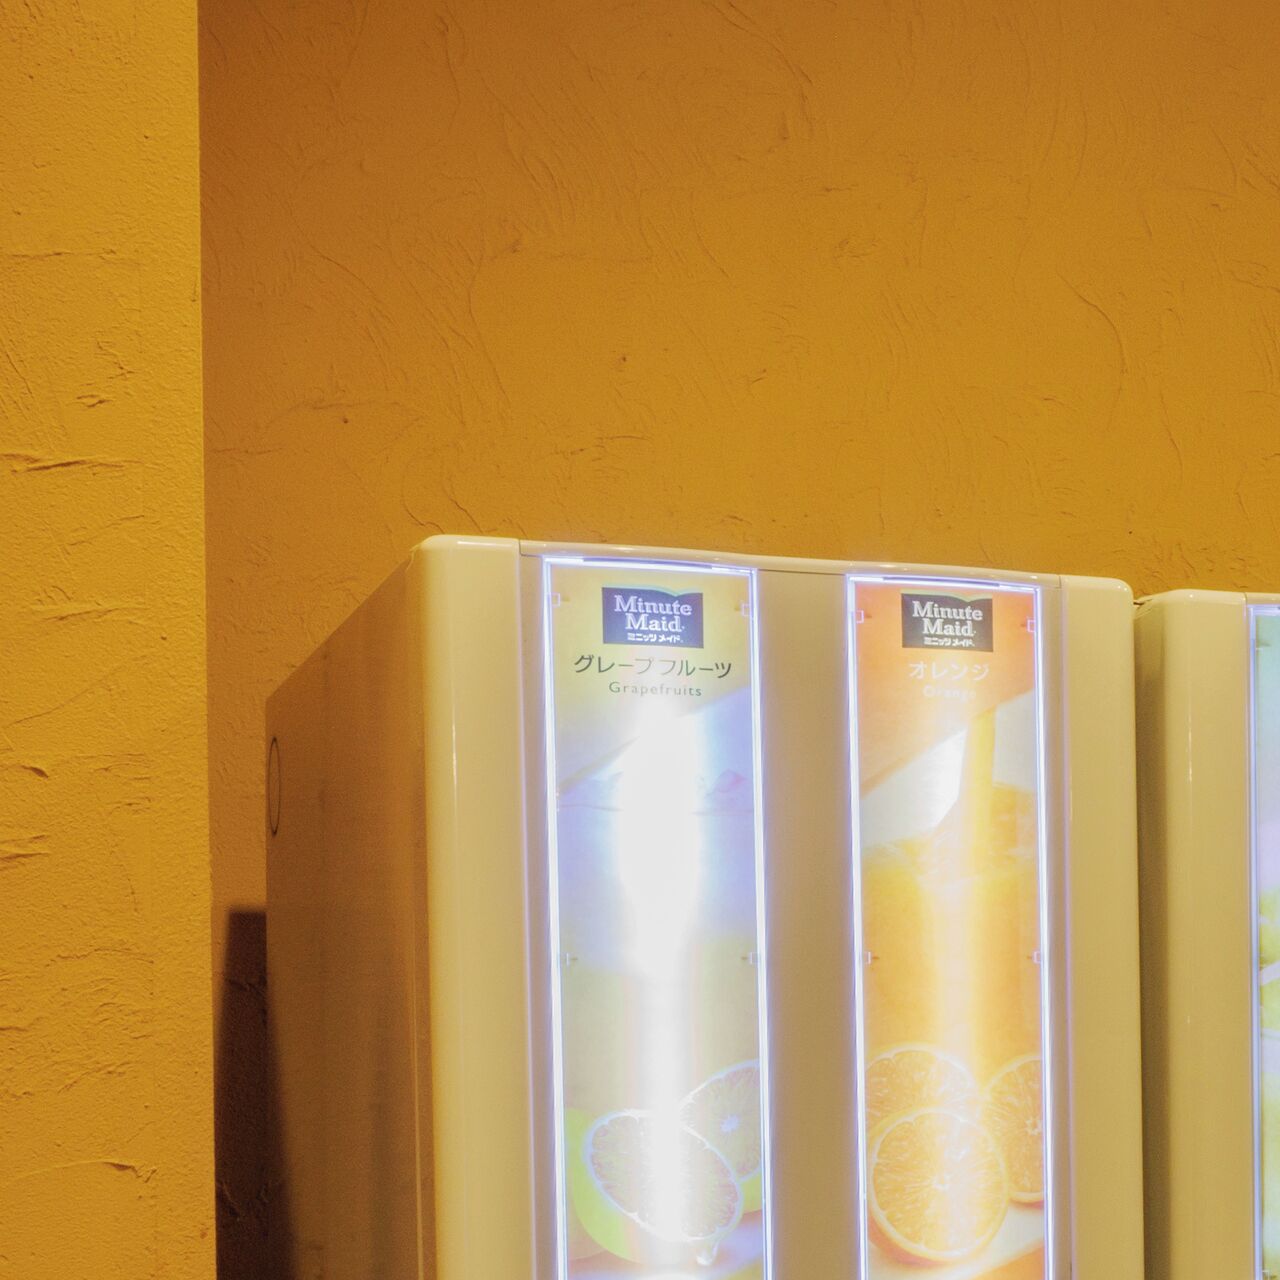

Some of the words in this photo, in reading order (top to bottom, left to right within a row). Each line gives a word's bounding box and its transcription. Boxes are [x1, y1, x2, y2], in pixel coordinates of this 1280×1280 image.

[614, 594, 692, 615] Minute
[912, 600, 983, 620] Minute
[625, 612, 682, 632] Maid
[922, 617, 975, 637] Maid
[909, 660, 990, 681] オレンジ
[608, 681, 703, 697] Grapefruits
